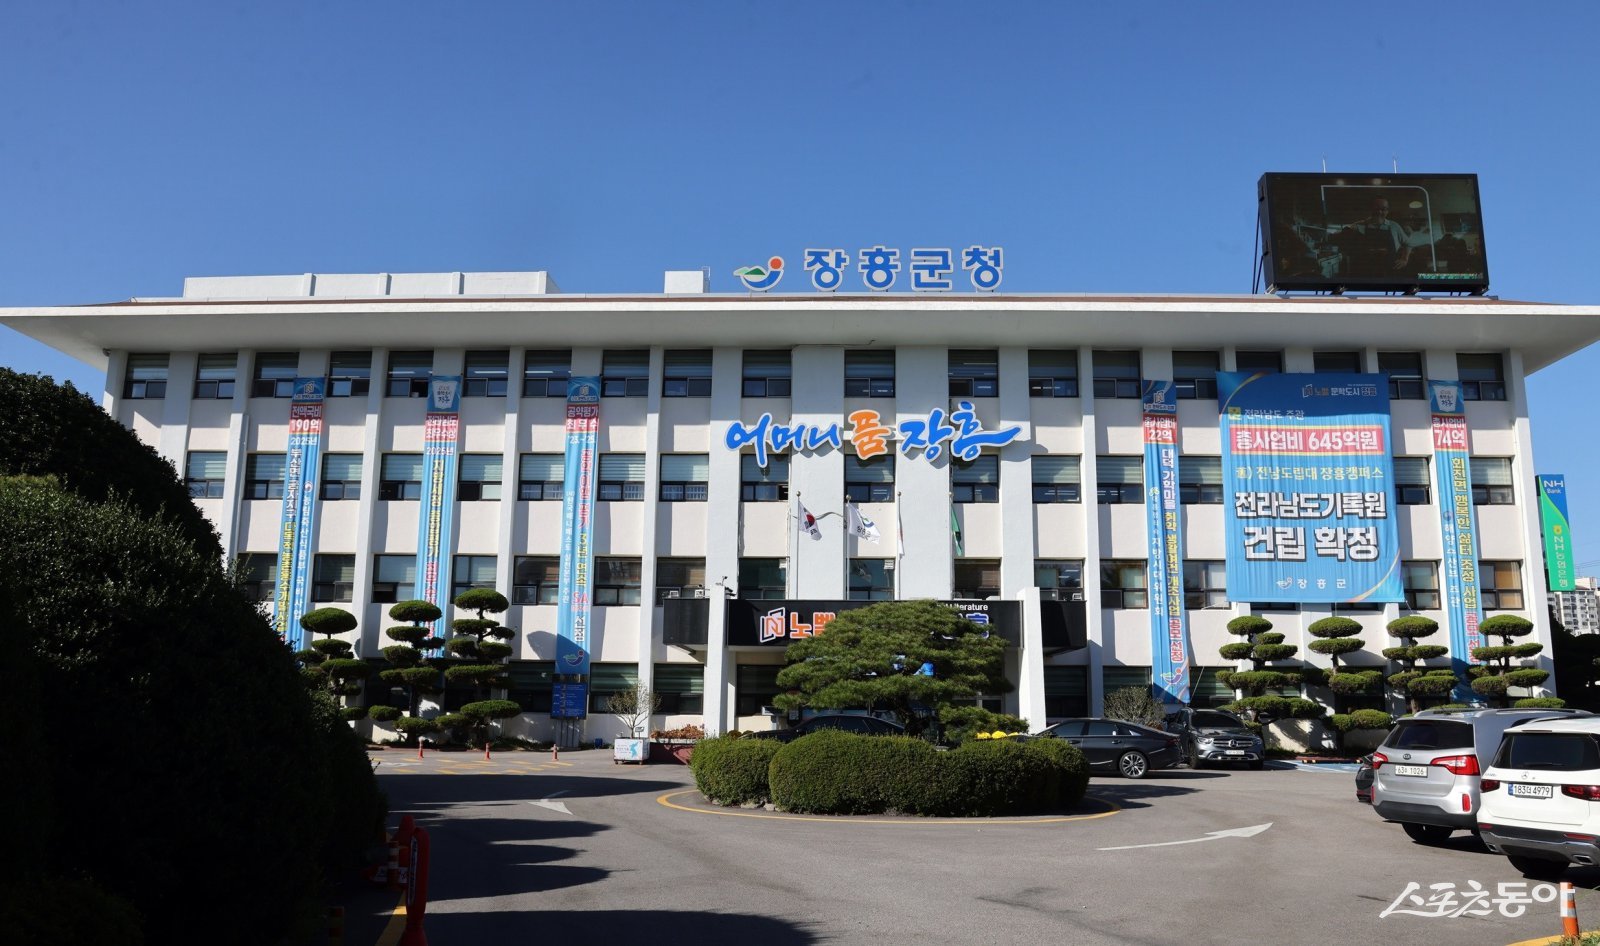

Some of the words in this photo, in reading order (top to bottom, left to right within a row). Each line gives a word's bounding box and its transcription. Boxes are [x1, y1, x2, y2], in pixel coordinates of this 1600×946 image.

[804, 246, 1003, 291] 장흥군청
[568, 406, 598, 418] 공약평가
[1244, 409, 1283, 420] 전라남도
[1286, 409, 1305, 421] 주관
[292, 419, 320, 432] 190억
[566, 418, 597, 430] 최우수
[725, 411, 843, 467] 어머니
[847, 408, 892, 461] 품
[897, 400, 1023, 463] 장흥
[290, 437, 317, 446] 2025년
[1149, 429, 1173, 441] 22억
[1236, 431, 1304, 450] 총사업비
[1308, 431, 1379, 450] 645억원
[1434, 429, 1465, 447] 74억
[426, 447, 454, 456] 2025년
[1161, 448, 1174, 469] 대덕
[290, 448, 302, 480] 부산면
[1256, 466, 1318, 480] 전남도립대
[1320, 466, 1384, 480] 장흥캠퍼스
[1452, 457, 1467, 492] 회진면
[1162, 471, 1176, 510] 가학마을
[1543, 480, 1564, 488] NH
[1235, 491, 1388, 519] 전라남도기록원
[1455, 494, 1470, 530] 행복한
[1244, 526, 1307, 562] 건립
[1314, 526, 1380, 562] 확정
[1459, 532, 1472, 556] 삶터
[1152, 537, 1164, 617] 지방시대위원회
[1461, 558, 1475, 582] 조성
[573, 591, 588, 604] SA
[1168, 596, 1181, 617] 사업
[1464, 585, 1477, 609] 사업
[1169, 618, 1182, 640] 공모
[1171, 641, 1184, 663] 선정
[1410, 767, 1425, 775] 1026
